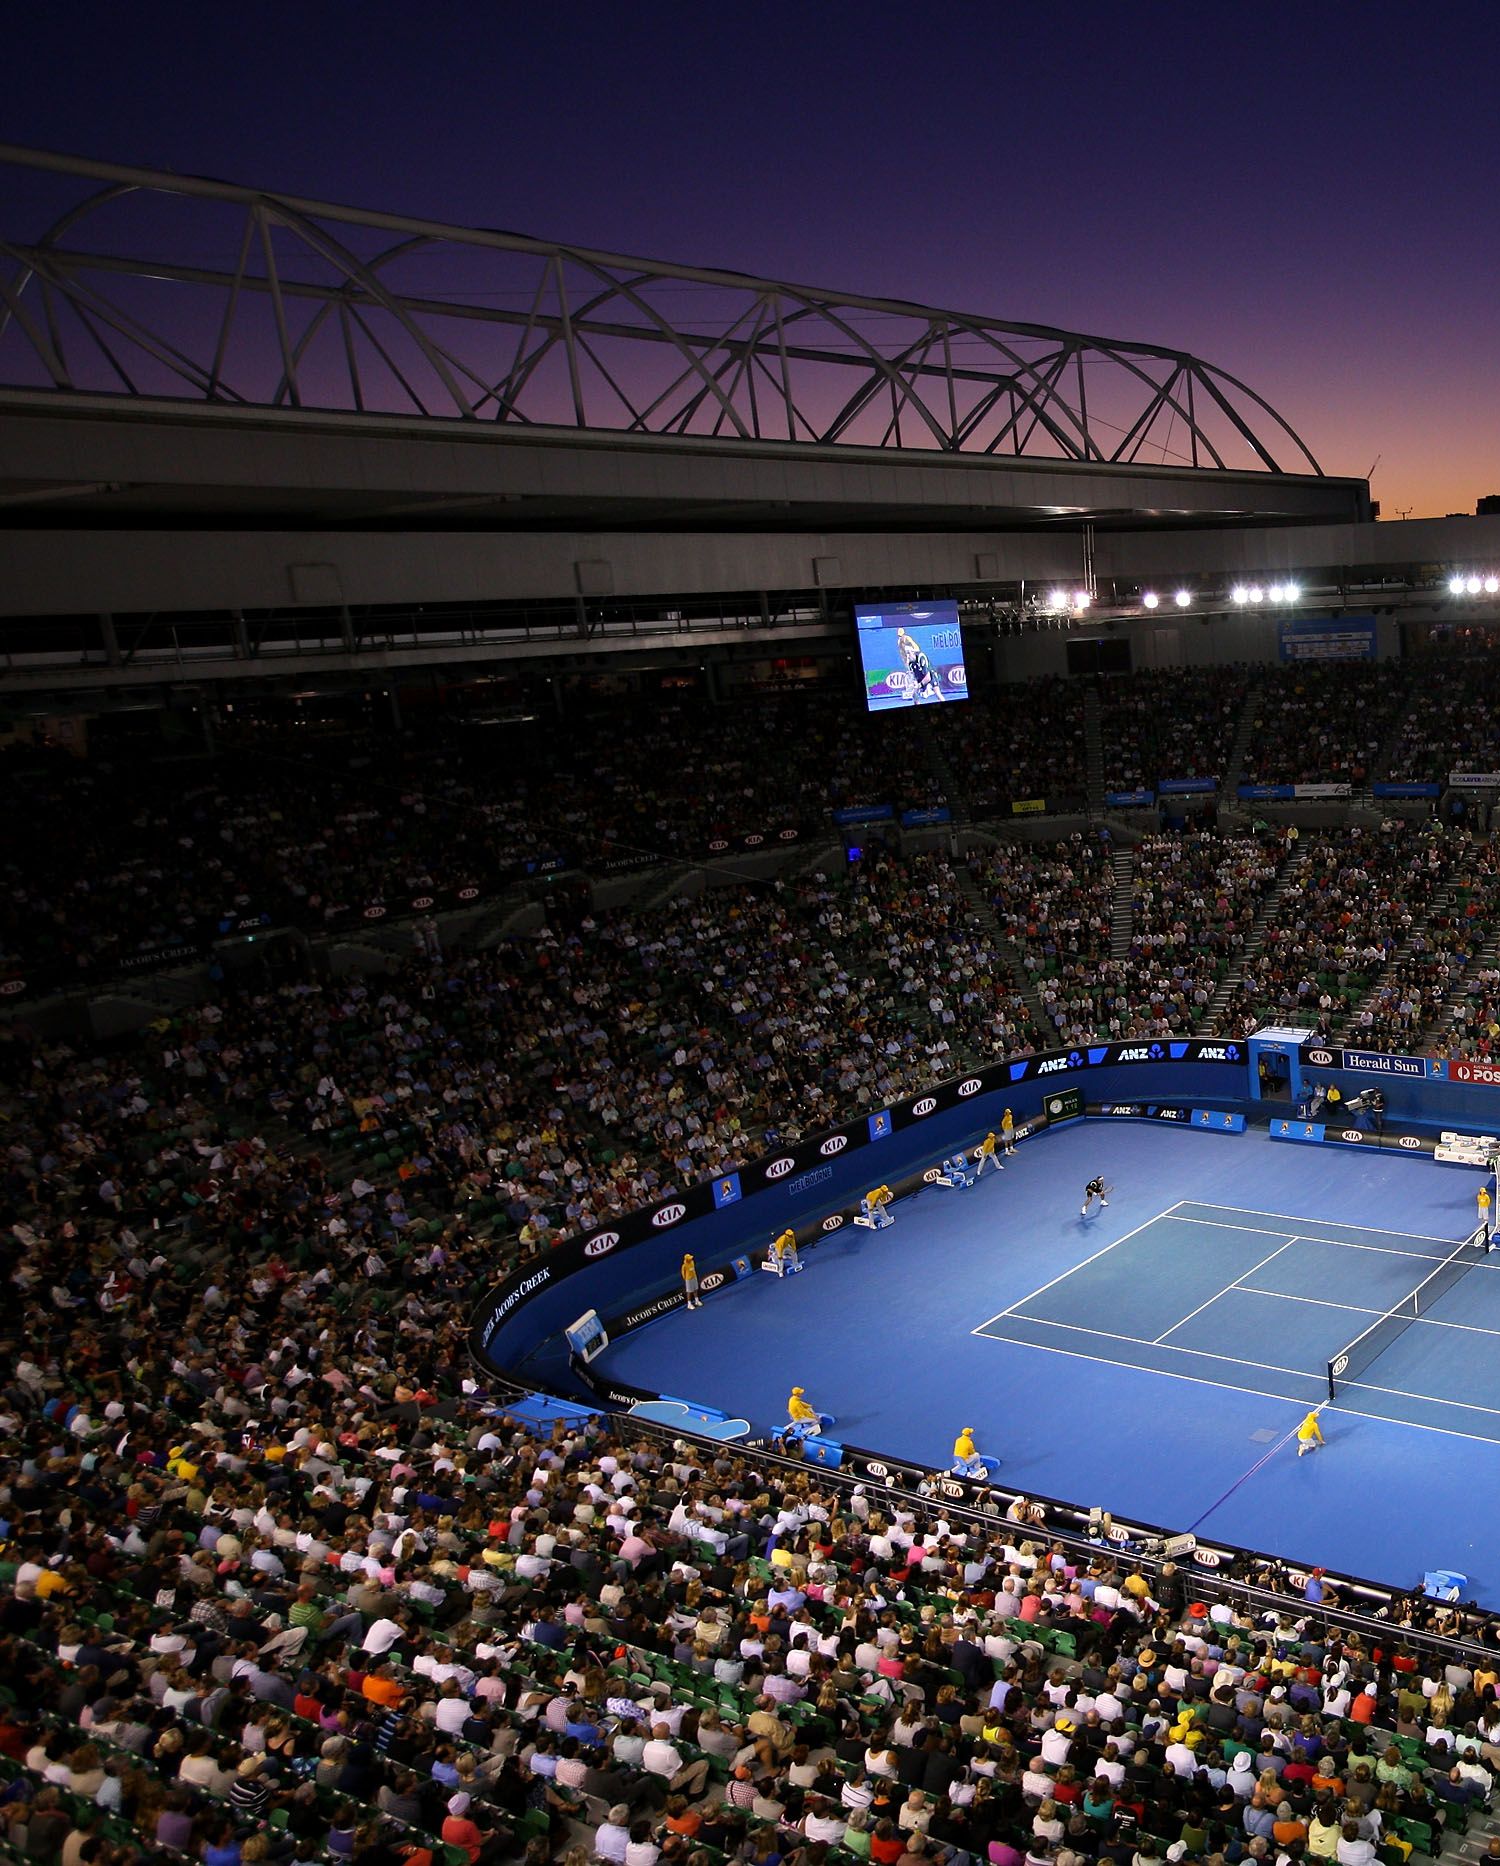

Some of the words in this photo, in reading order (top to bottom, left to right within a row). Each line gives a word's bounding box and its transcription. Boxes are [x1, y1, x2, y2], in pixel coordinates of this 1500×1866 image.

[747, 835, 763, 844] KIA
[781, 830, 797, 838] KIA
[710, 841, 726, 850] KIA
[461, 889, 478, 898] KIA
[415, 897, 433, 908] KIA
[1118, 1048, 1149, 1061] ANZ
[1197, 1047, 1226, 1060] ANZ
[1312, 1052, 1330, 1062] KIA
[1037, 1057, 1068, 1074] ANZ
[1350, 1056, 1390, 1070] Herald
[1394, 1060, 1419, 1073] Sun
[961, 1081, 979, 1094] KIA
[916, 1100, 934, 1113] KIA
[1112, 1106, 1132, 1115] ANZ
[1160, 1109, 1178, 1119] ANZ
[1015, 1127, 1029, 1140] ANZ
[1344, 1131, 1360, 1140] KIA
[825, 1138, 844, 1153] KIA
[1401, 1138, 1417, 1146] KIA
[770, 1160, 792, 1176] KIA
[789, 1166, 832, 1195] MELBOURNE
[924, 1170, 941, 1181] KIA
[657, 1206, 681, 1224] KIA
[825, 1217, 841, 1229] KIA
[589, 1234, 615, 1253] KIA
[703, 1275, 721, 1289] KIA
[495, 1289, 520, 1323] JACOB'S
[519, 1266, 551, 1296] CREEK
[626, 1307, 658, 1326] JACOB'S
[657, 1294, 685, 1311] CREEK
[1335, 1357, 1347, 1373] KIA
[608, 1391, 631, 1405] JACOB'S
[869, 1465, 885, 1476] KIA
[944, 1484, 961, 1496] KIA
[1108, 1528, 1127, 1540] KIA
[1197, 1551, 1217, 1564] KIA
[1484, 1821, 1492, 1830] F
